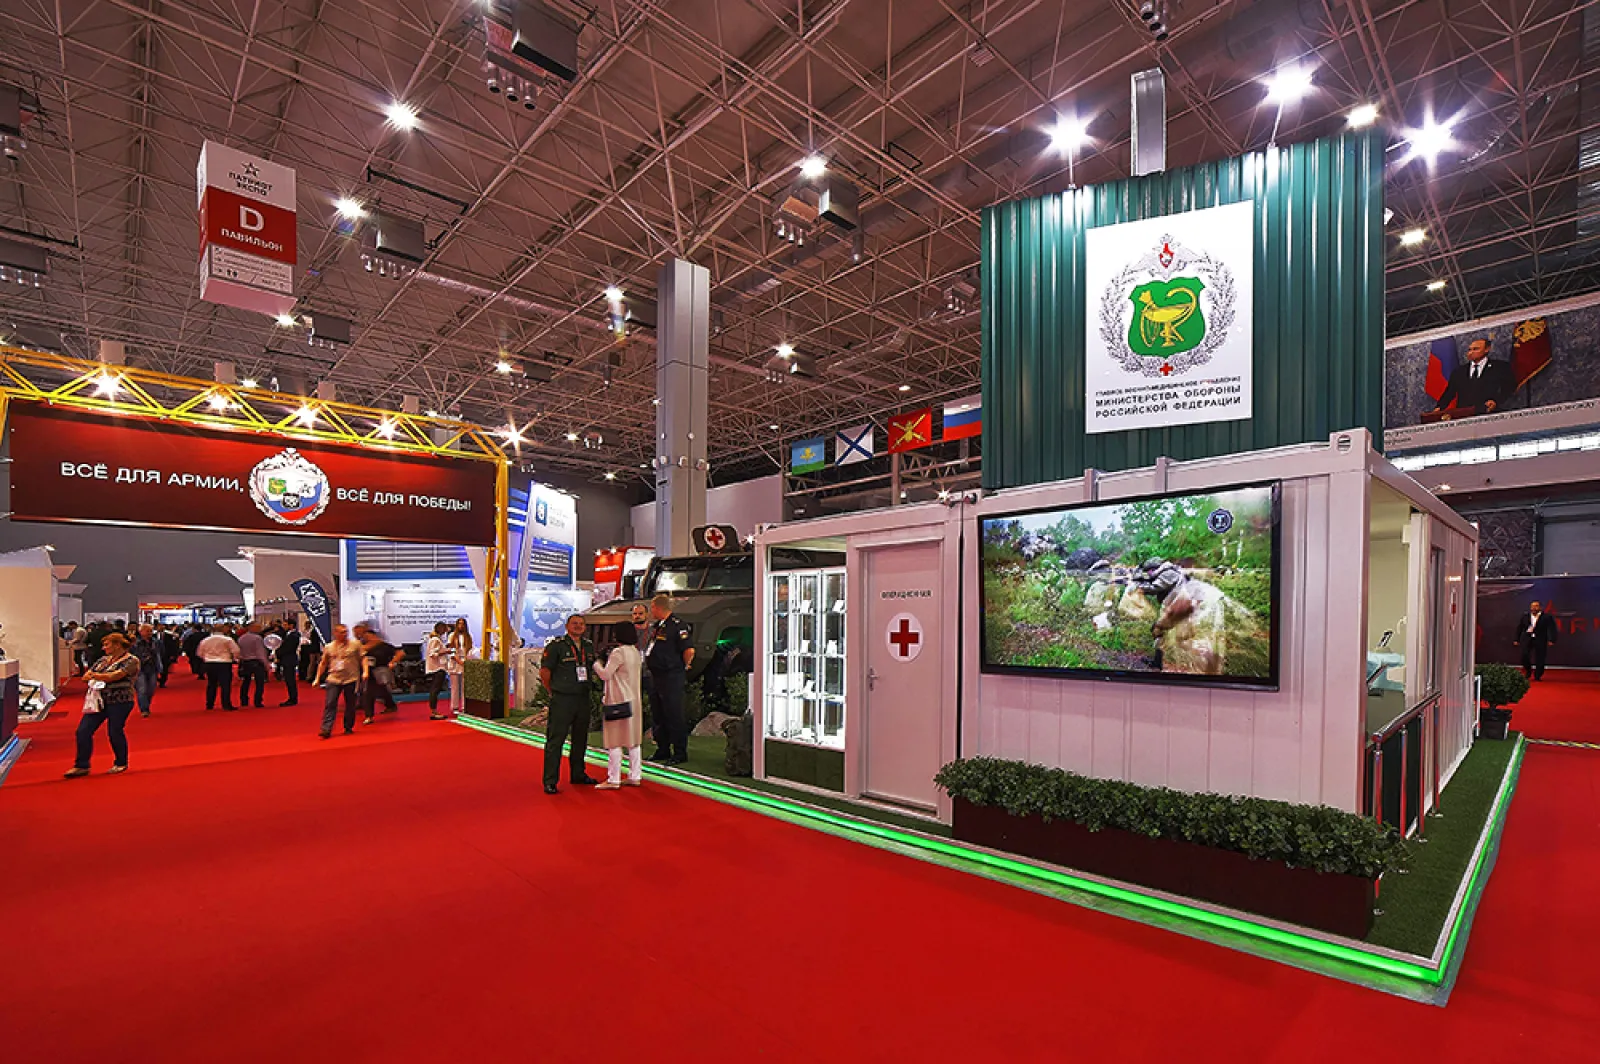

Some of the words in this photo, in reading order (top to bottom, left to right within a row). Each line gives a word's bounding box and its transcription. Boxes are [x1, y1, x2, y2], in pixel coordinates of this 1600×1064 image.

[228, 172, 272, 191] ПАТРИОТ
[236, 181, 268, 196] ЭКСПО
[240, 205, 265, 232] D
[221, 228, 283, 252] ПАВИЛЬОН
[1095, 391, 1180, 407] МИНИСТЕРСТВА
[1183, 385, 1241, 398] ОБОРОНЫ
[1095, 401, 1168, 418] РОССИЙСКОЙ
[1172, 396, 1241, 410] ФЕДЕРАЦИИ
[61, 461, 109, 480] ВСЁ
[115, 467, 161, 484] ДЛЯ
[167, 473, 244, 493] АРМИИ,
[336, 487, 369, 502] ВСЁ
[373, 491, 404, 505] ДЛЯ
[408, 495, 472, 511] ПОБЕДЫ!
